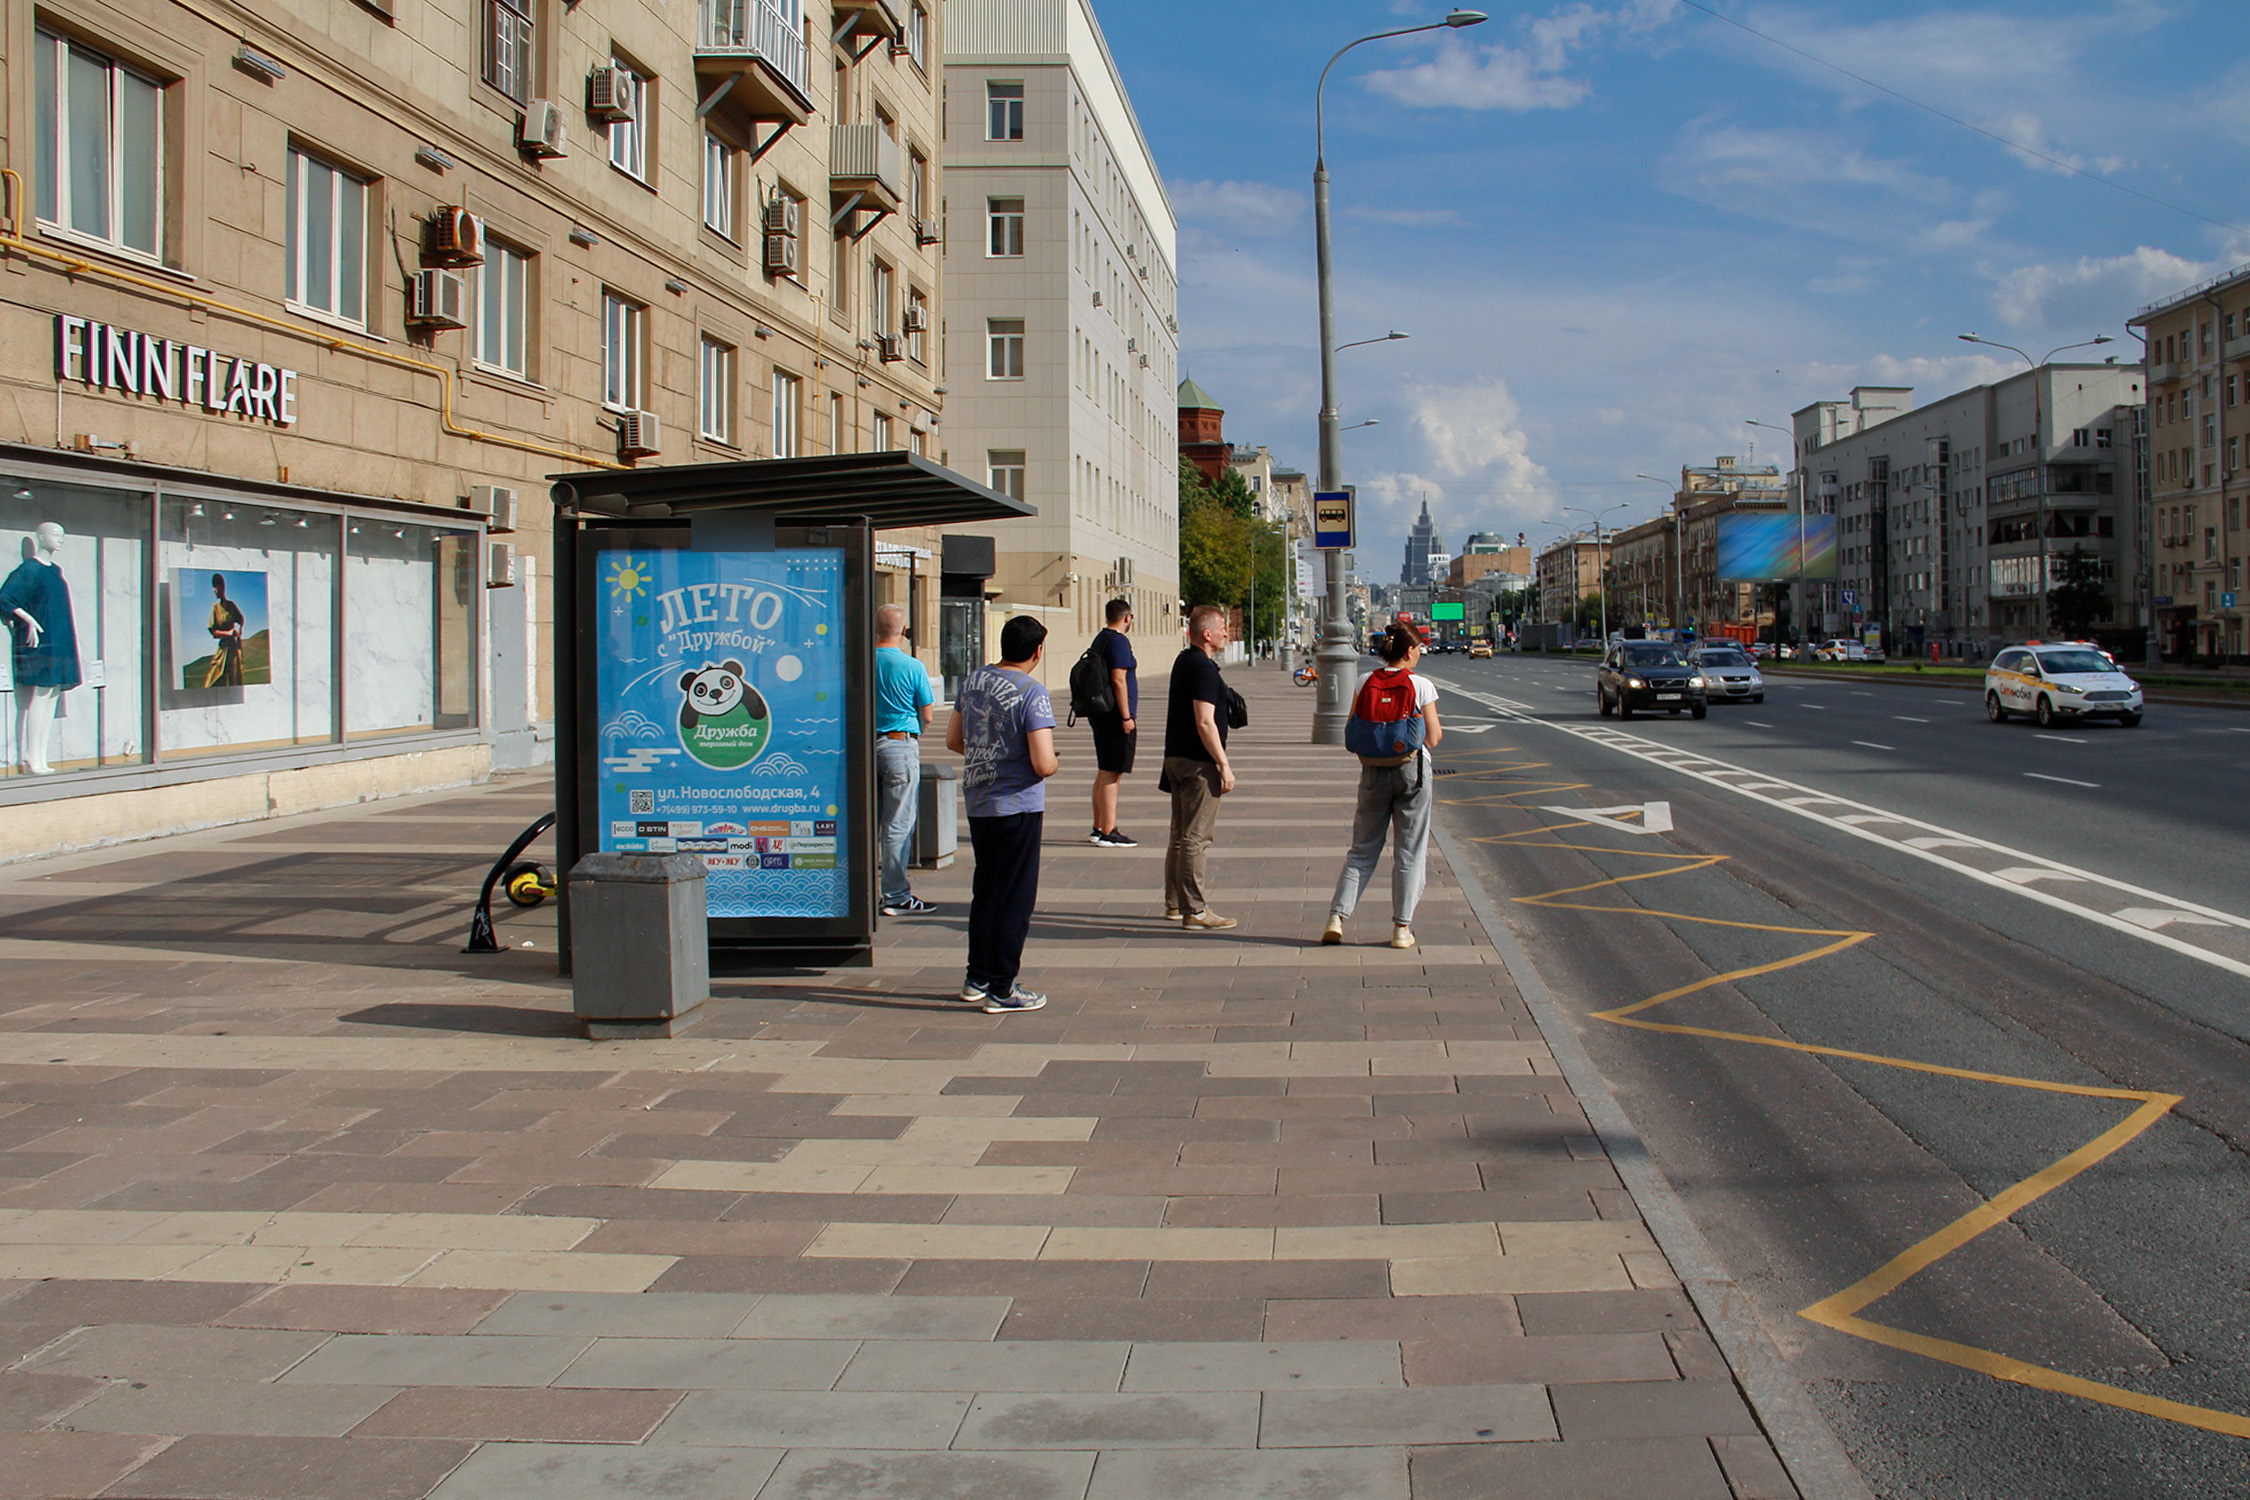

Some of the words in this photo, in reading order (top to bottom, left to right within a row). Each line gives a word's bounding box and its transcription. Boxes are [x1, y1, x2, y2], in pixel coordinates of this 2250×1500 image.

[56, 314, 174, 400] FINN
[182, 345, 298, 426] FLARE
[656, 583, 783, 635] ЛЕТО
[657, 644, 669, 658] с
[694, 723, 758, 741] Дружба
[699, 740, 737, 748] торговый
[738, 740, 753, 748] дом
[657, 788, 680, 802] ул.
[681, 784, 808, 801] Новослободская,
[810, 785, 821, 798] 4
[691, 804, 738, 814] 973-59-10
[743, 803, 821, 816] www.drugba.ru
[616, 825, 635, 833] ecco
[730, 841, 753, 850] modi
